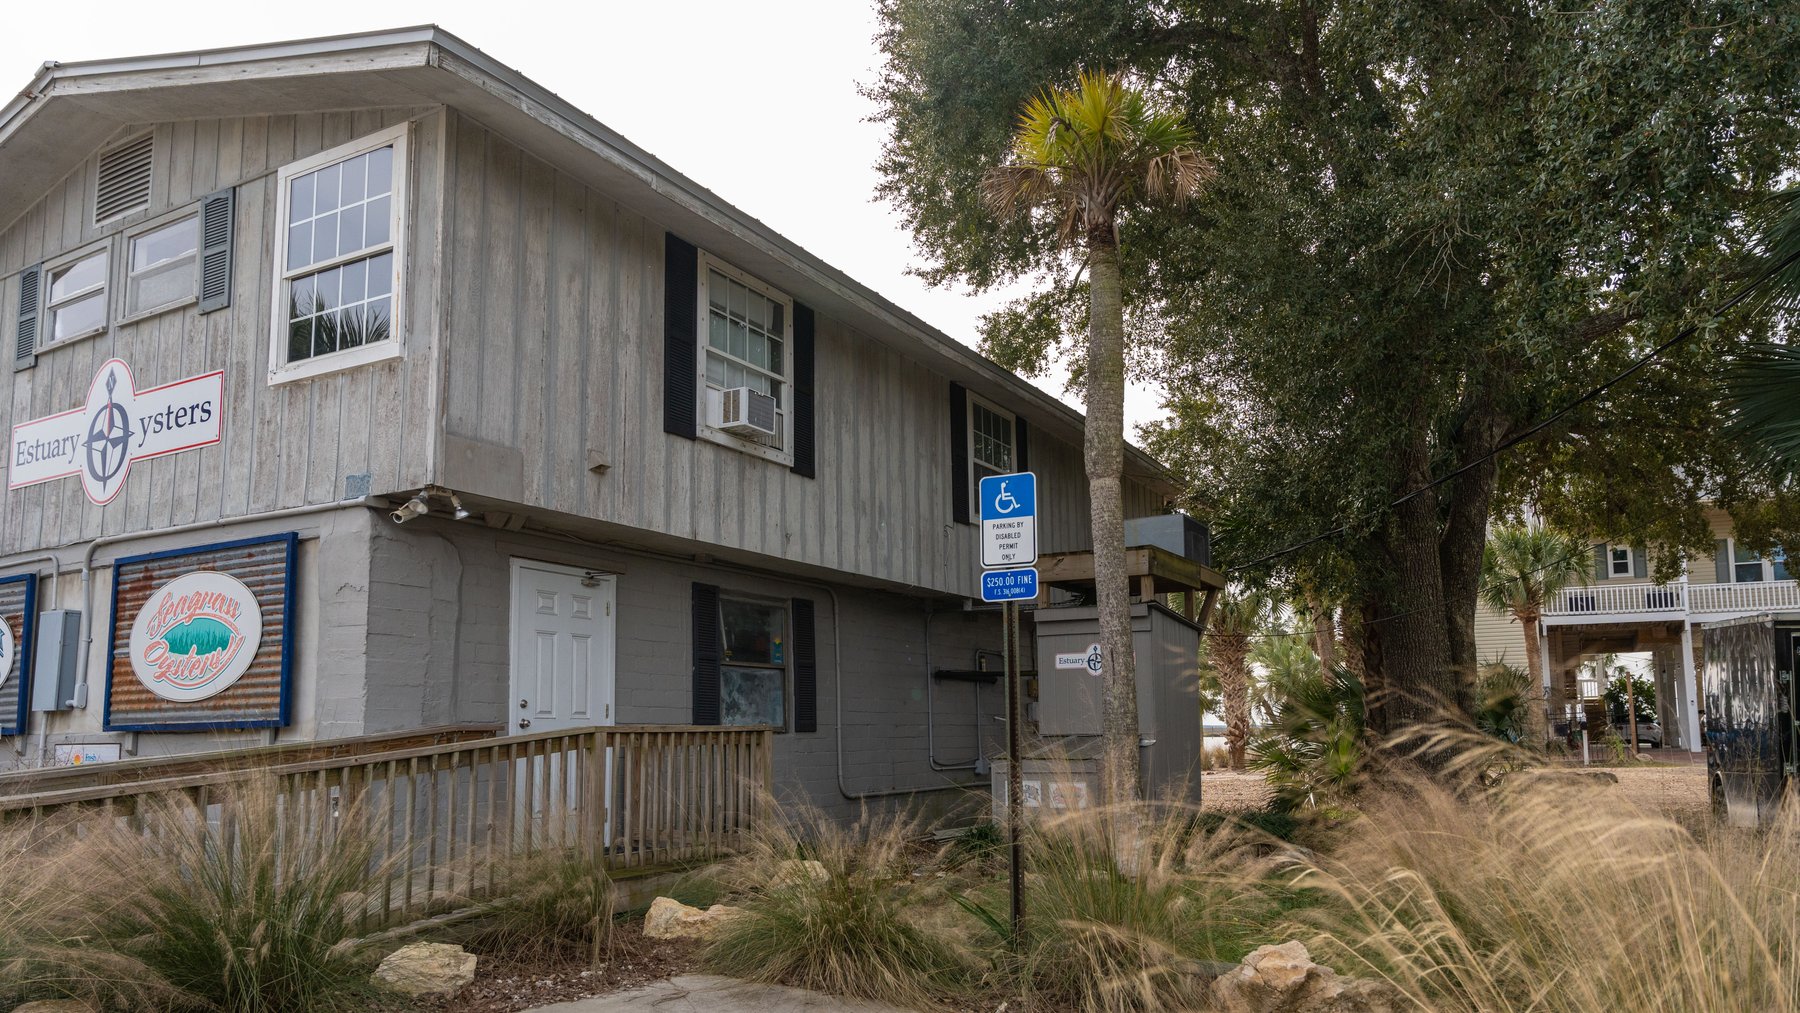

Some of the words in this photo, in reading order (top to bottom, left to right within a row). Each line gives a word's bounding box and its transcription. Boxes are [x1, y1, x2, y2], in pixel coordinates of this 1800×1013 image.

[15, 434, 81, 467] Estuary
[992, 522, 1016, 530] PARKING
[995, 532, 1022, 541] DISABLED
[1001, 553, 1016, 561] ONLY
[987, 576, 1015, 588] $250.00
[1017, 575, 1033, 585] FINE
[146, 591, 241, 638] Seagrass
[143, 636, 239, 686] Oysters
[1058, 657, 1086, 666] Estuary
